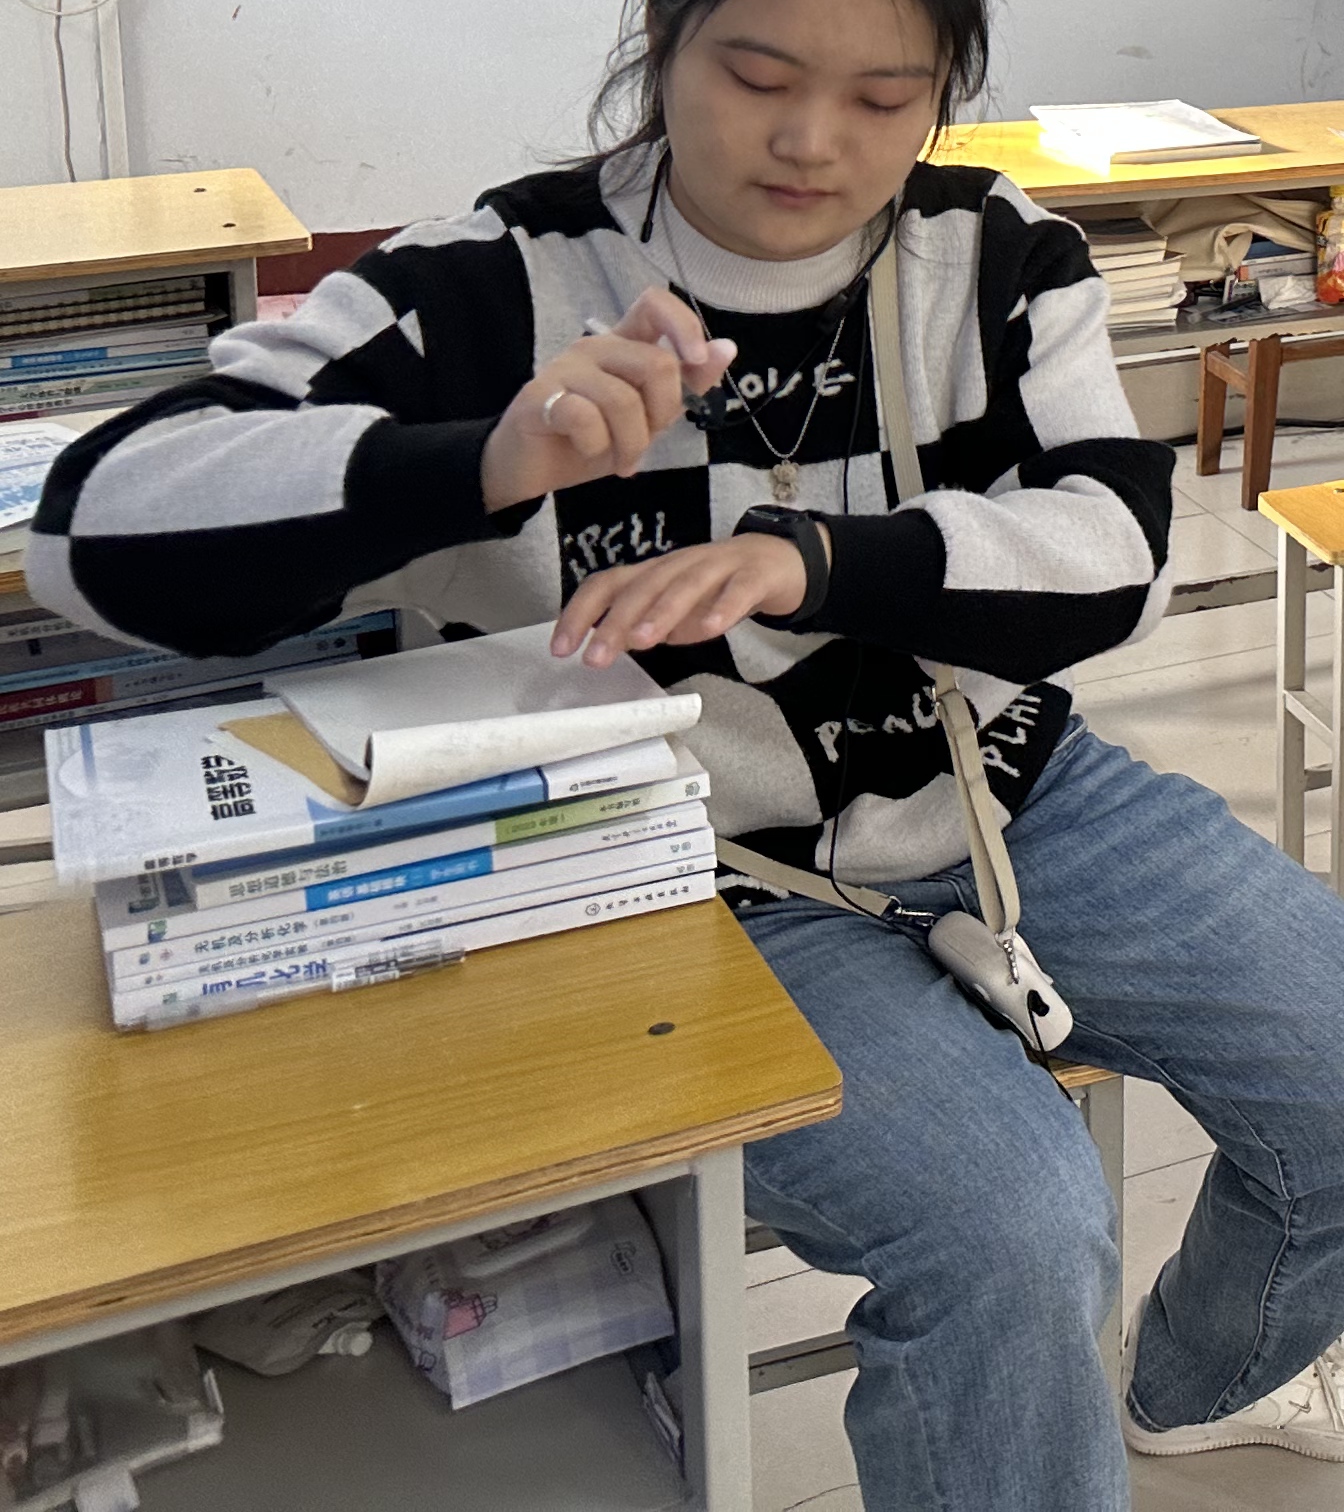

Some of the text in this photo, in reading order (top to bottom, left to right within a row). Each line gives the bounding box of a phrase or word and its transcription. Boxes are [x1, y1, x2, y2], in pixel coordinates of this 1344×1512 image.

[193, 920, 309, 954] 无机及分析化学
